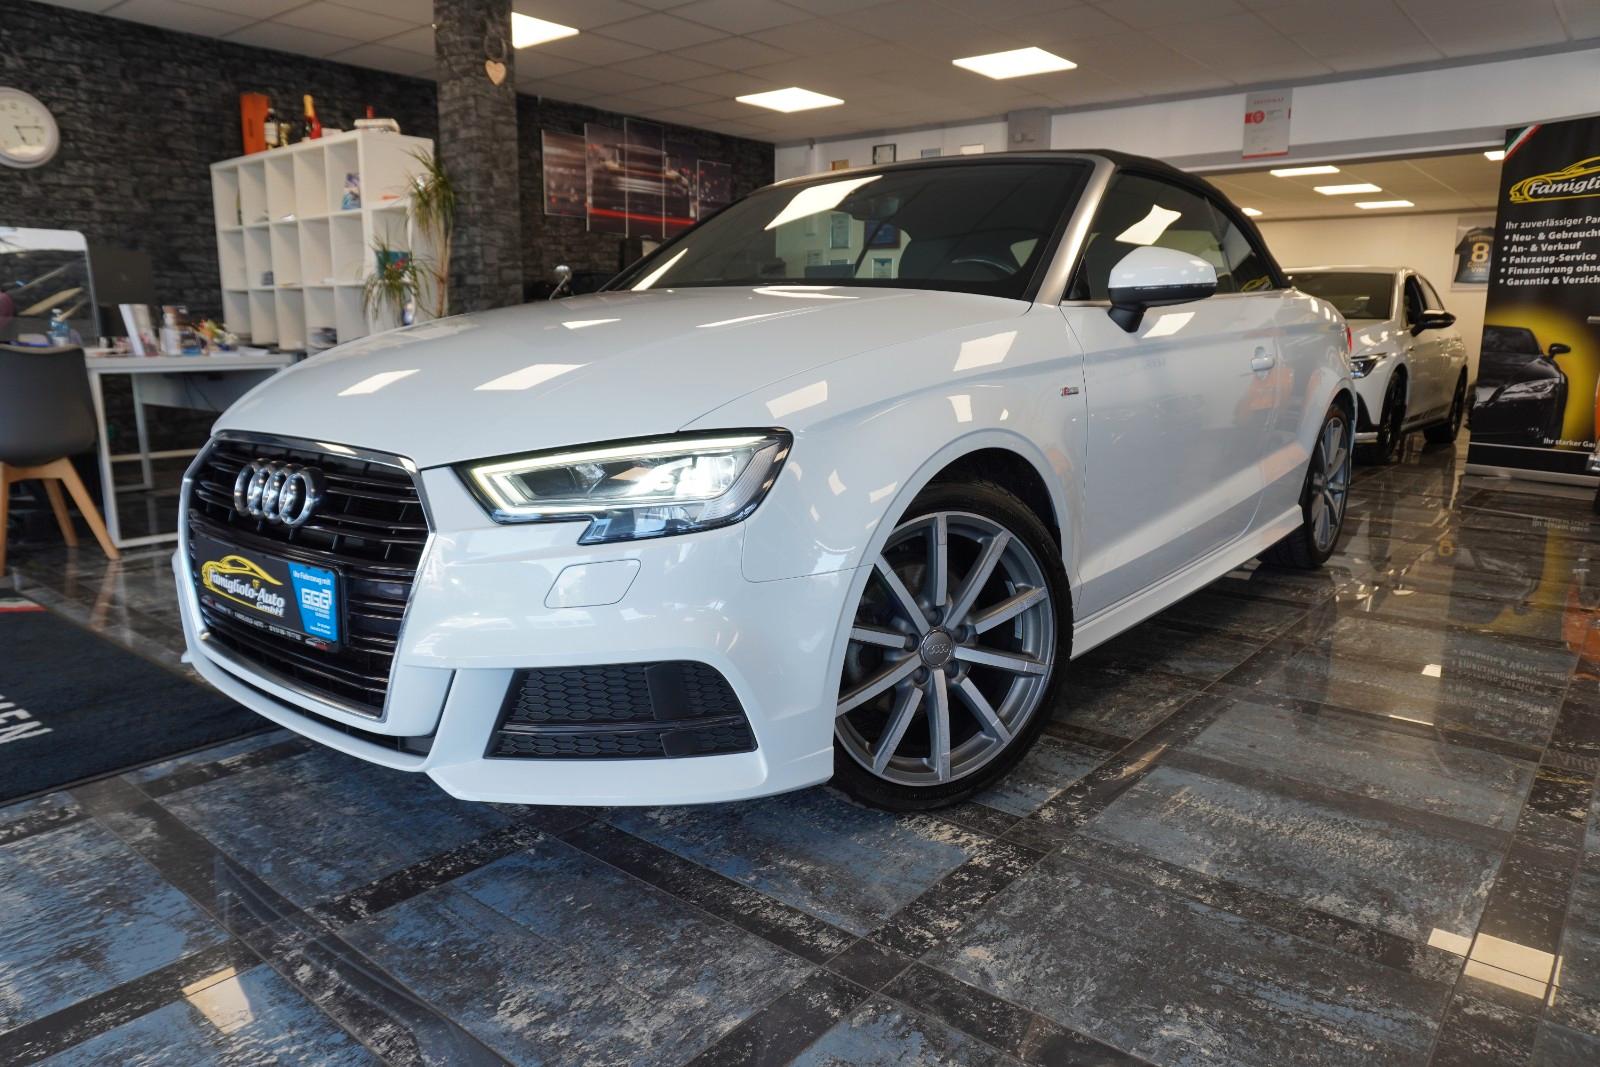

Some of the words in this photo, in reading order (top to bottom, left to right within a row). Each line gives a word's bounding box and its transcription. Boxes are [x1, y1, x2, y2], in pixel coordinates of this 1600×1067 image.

[1505, 221, 1519, 230] Ihr
[1520, 217, 1583, 228] zuverlässiger
[1511, 232, 1536, 242] Neu-
[1538, 232, 1546, 241] &
[1471, 242, 1489, 263] 8
[1510, 243, 1528, 253] An-
[1530, 243, 1538, 252] &
[1540, 240, 1582, 251] Verkauf
[1509, 251, 1597, 264] Fahrzeug-Service
[1507, 265, 1573, 275] Finanzierung
[1506, 276, 1550, 286] Garantie
[1552, 276, 1560, 285] &
[1543, 437, 1554, 445] Ihr
[1555, 438, 1581, 447] starker
[256, 601, 285, 618] GmbH
